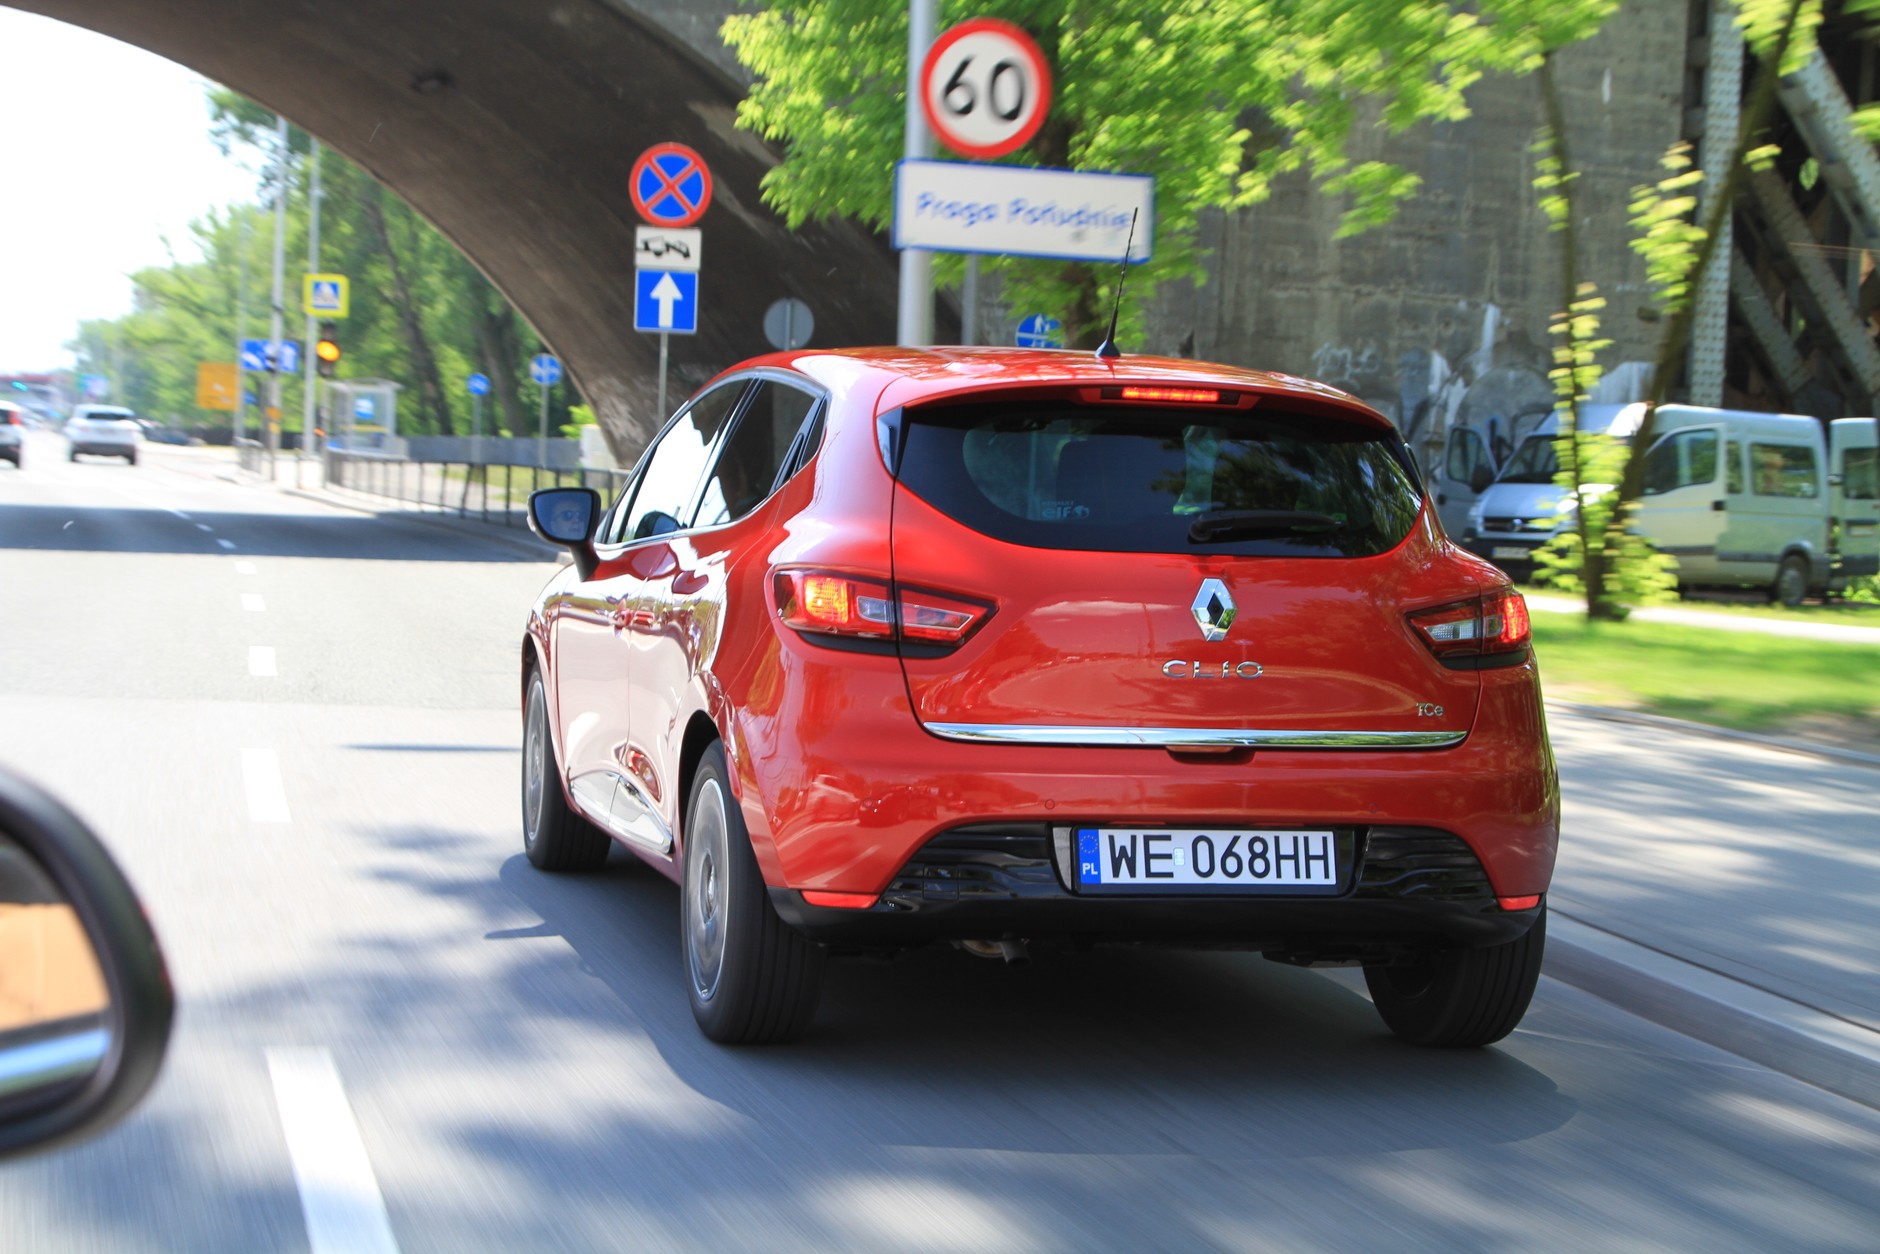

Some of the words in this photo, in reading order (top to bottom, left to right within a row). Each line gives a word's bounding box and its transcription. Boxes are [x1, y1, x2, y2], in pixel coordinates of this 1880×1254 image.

[941, 55, 1026, 121] 60
[916, 191, 999, 228] Praga
[1162, 660, 1264, 679] CLIO
[1415, 702, 1444, 717] TCe
[1082, 863, 1098, 875] PL
[1108, 834, 1174, 879] WE
[1191, 835, 1330, 880] 068HH
